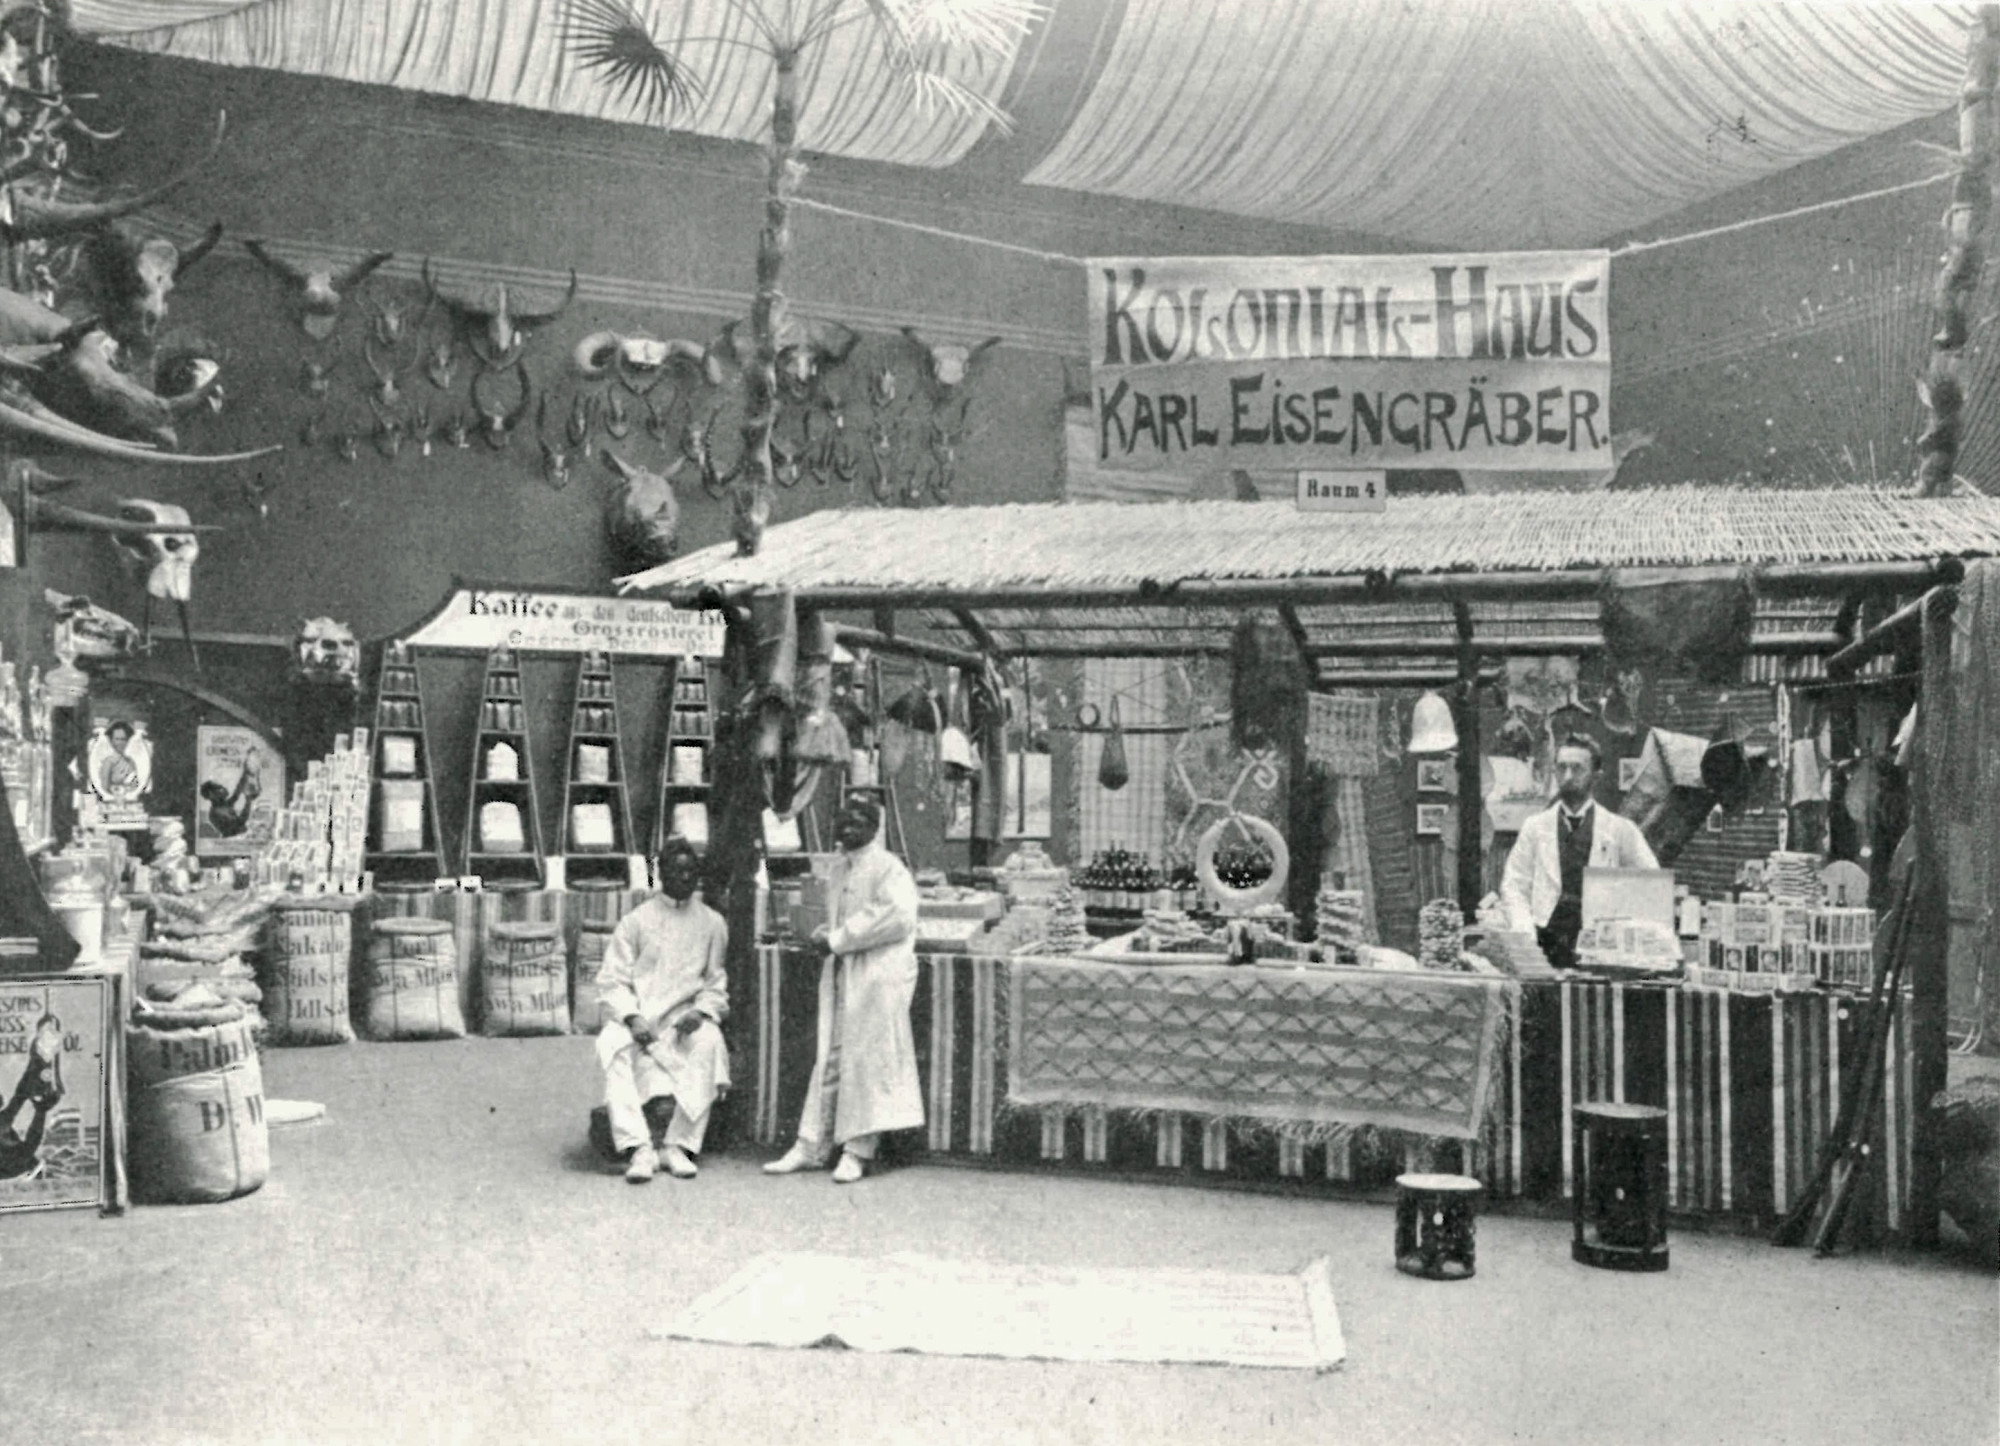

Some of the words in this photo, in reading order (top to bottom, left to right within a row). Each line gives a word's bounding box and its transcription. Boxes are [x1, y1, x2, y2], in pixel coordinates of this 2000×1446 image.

[1100, 379, 1219, 459] KARL
[1307, 479, 1360, 498] Raum
[1365, 481, 1377, 499] 4
[468, 590, 559, 618] Kaffee
[626, 605, 692, 625] deutschen
